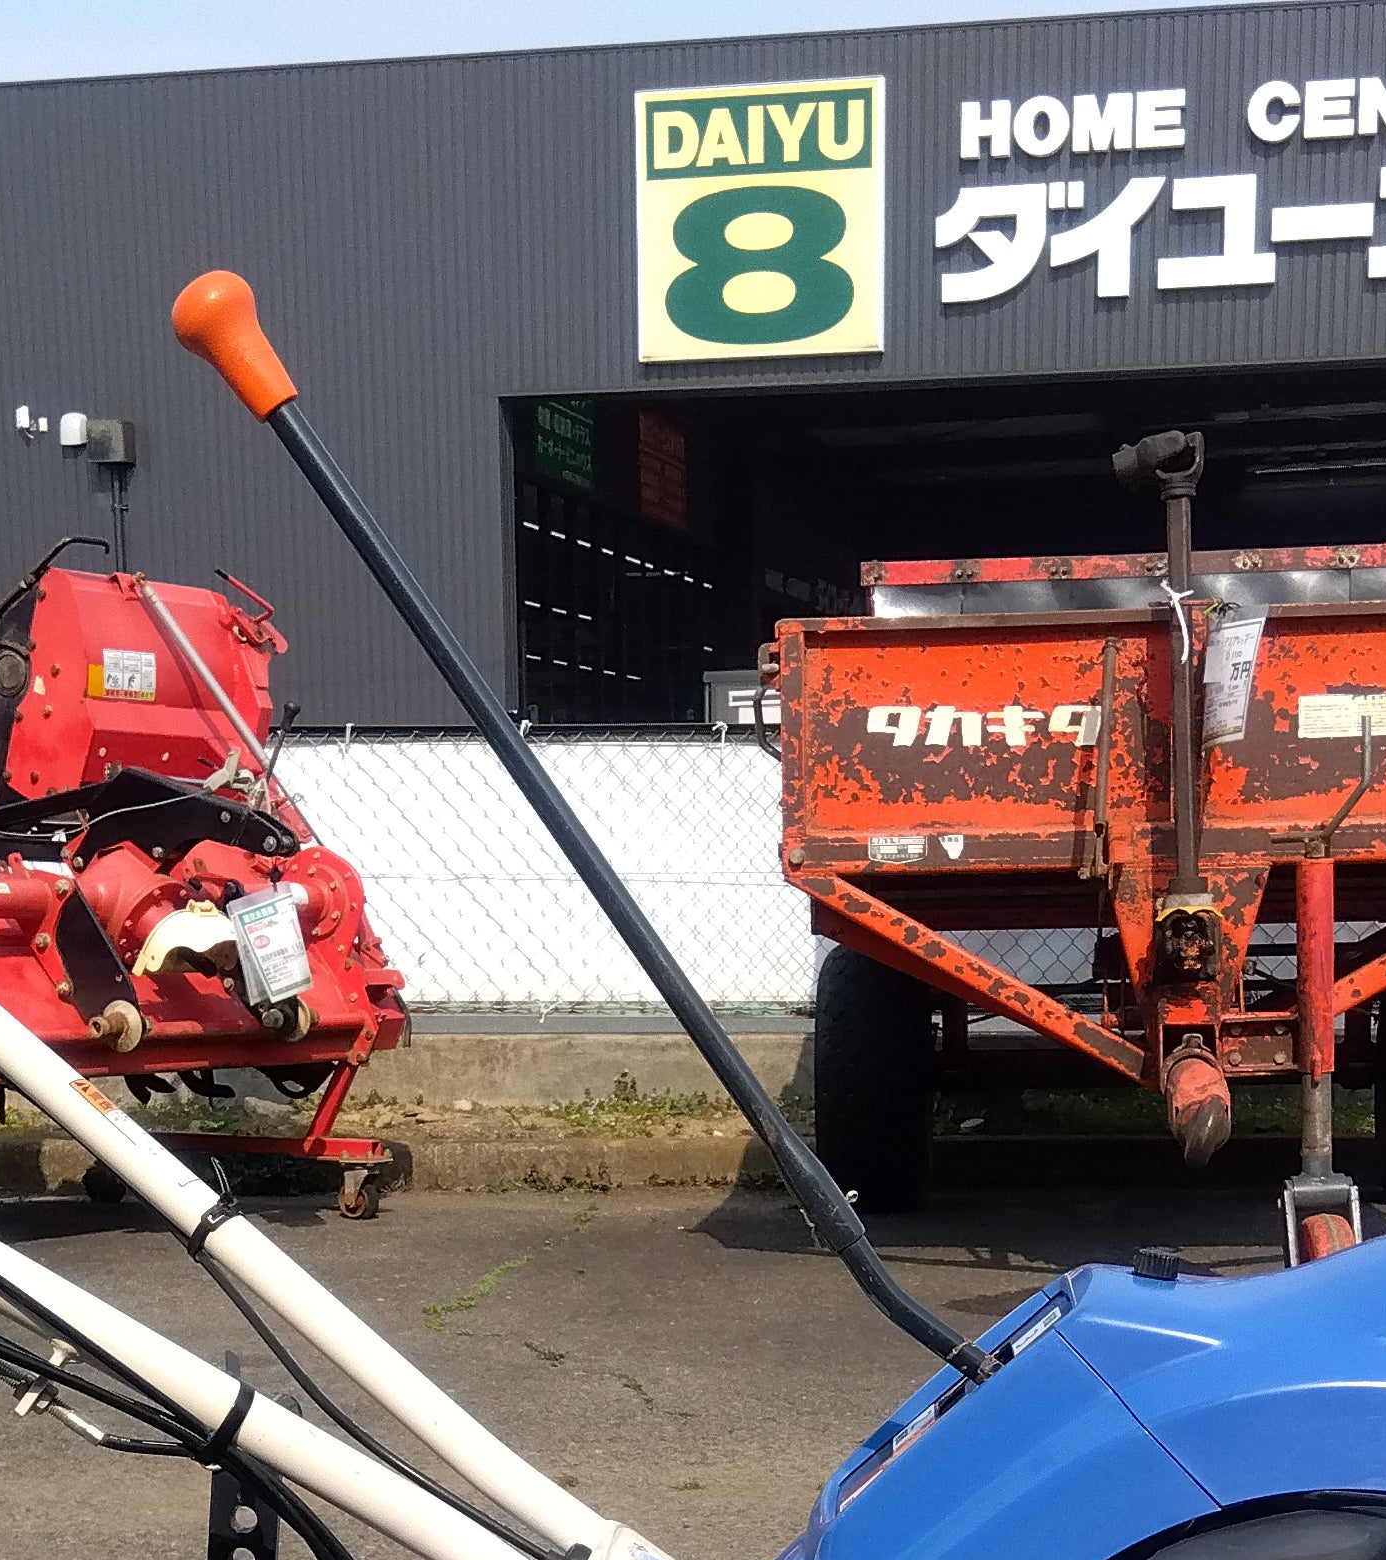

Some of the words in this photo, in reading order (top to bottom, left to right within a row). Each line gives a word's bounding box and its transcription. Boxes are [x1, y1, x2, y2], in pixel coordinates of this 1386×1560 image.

[652, 97, 868, 169] DAIYU
[960, 88, 1186, 160] HOME
[664, 185, 856, 345] 8
[866, 704, 1103, 747] タカキタ
